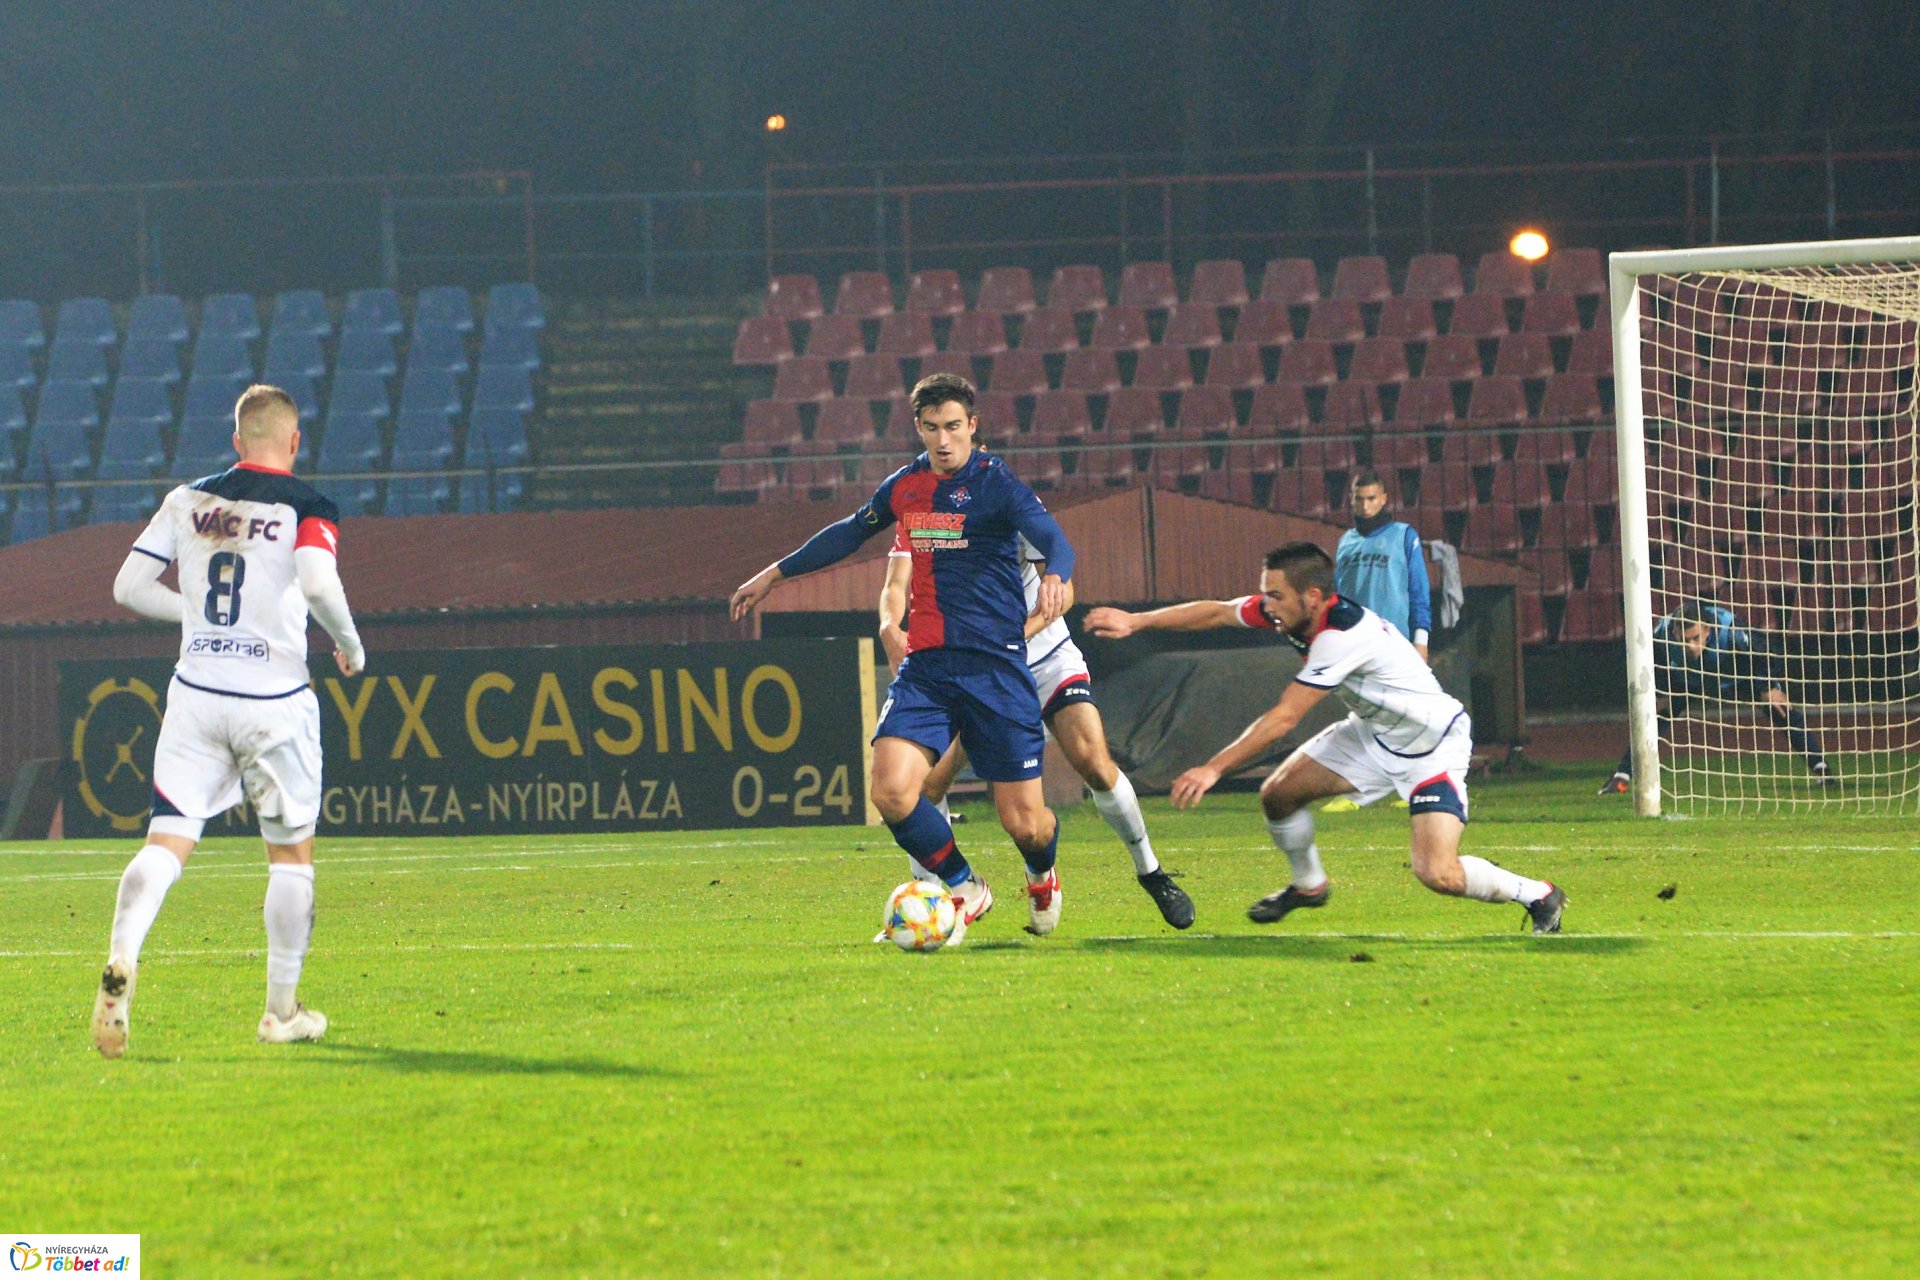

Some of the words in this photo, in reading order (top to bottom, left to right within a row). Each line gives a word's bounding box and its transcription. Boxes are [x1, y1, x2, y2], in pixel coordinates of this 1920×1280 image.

[192, 507, 242, 538] VÁC
[247, 518, 282, 541] FC
[204, 551, 246, 627] 8
[311, 674, 443, 761] YX
[464, 664, 802, 759] CASINO
[732, 764, 853, 817] 0-24
